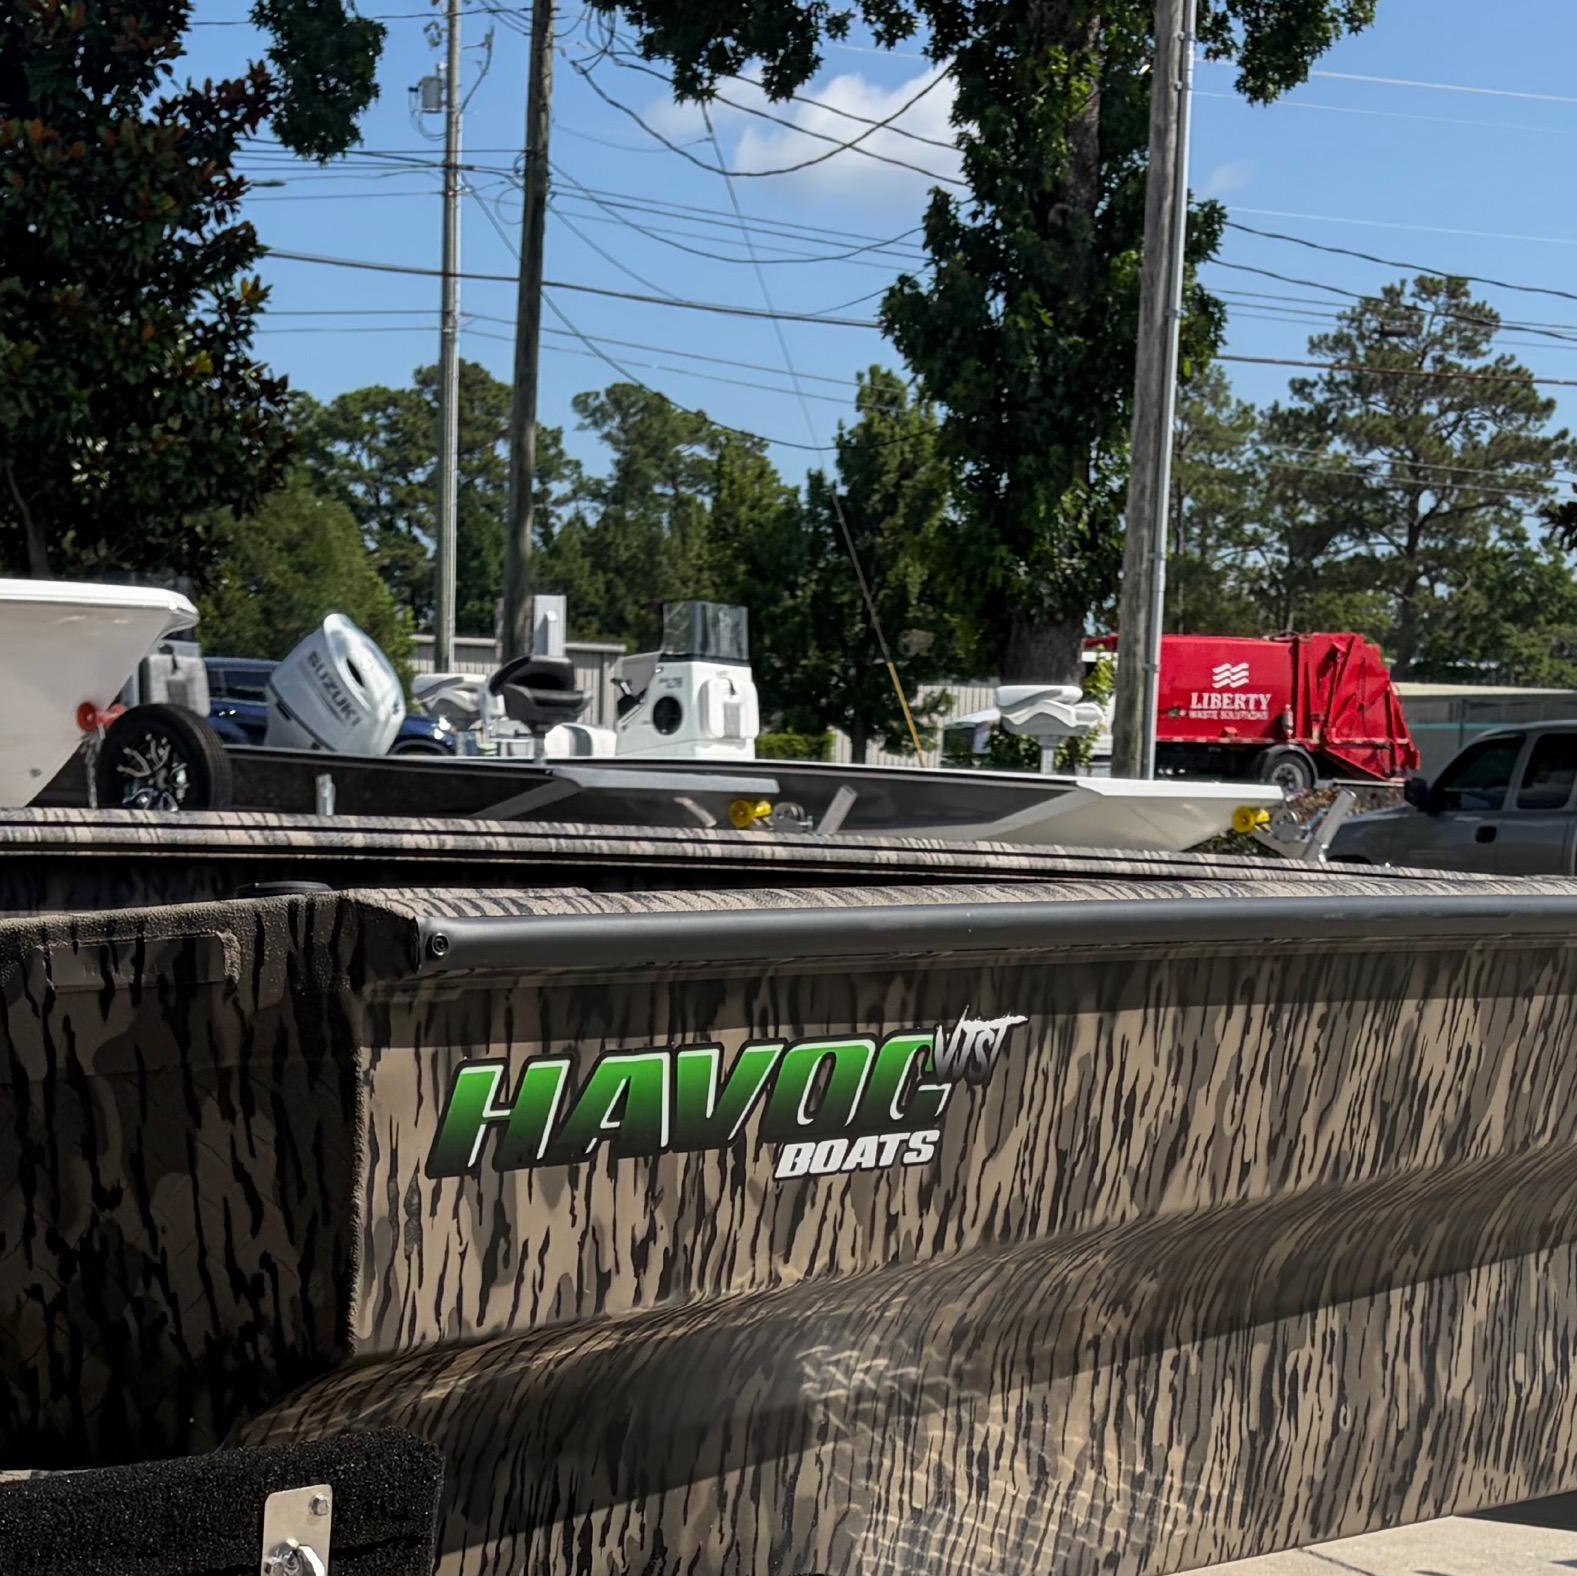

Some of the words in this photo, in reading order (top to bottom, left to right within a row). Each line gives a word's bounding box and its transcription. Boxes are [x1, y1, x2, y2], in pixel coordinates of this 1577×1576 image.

[308, 651, 361, 727] SUZUKI
[1190, 692, 1272, 711] LIBERTY
[427, 1031, 952, 1178] HAVOC
[774, 1128, 941, 1182] BOATS
